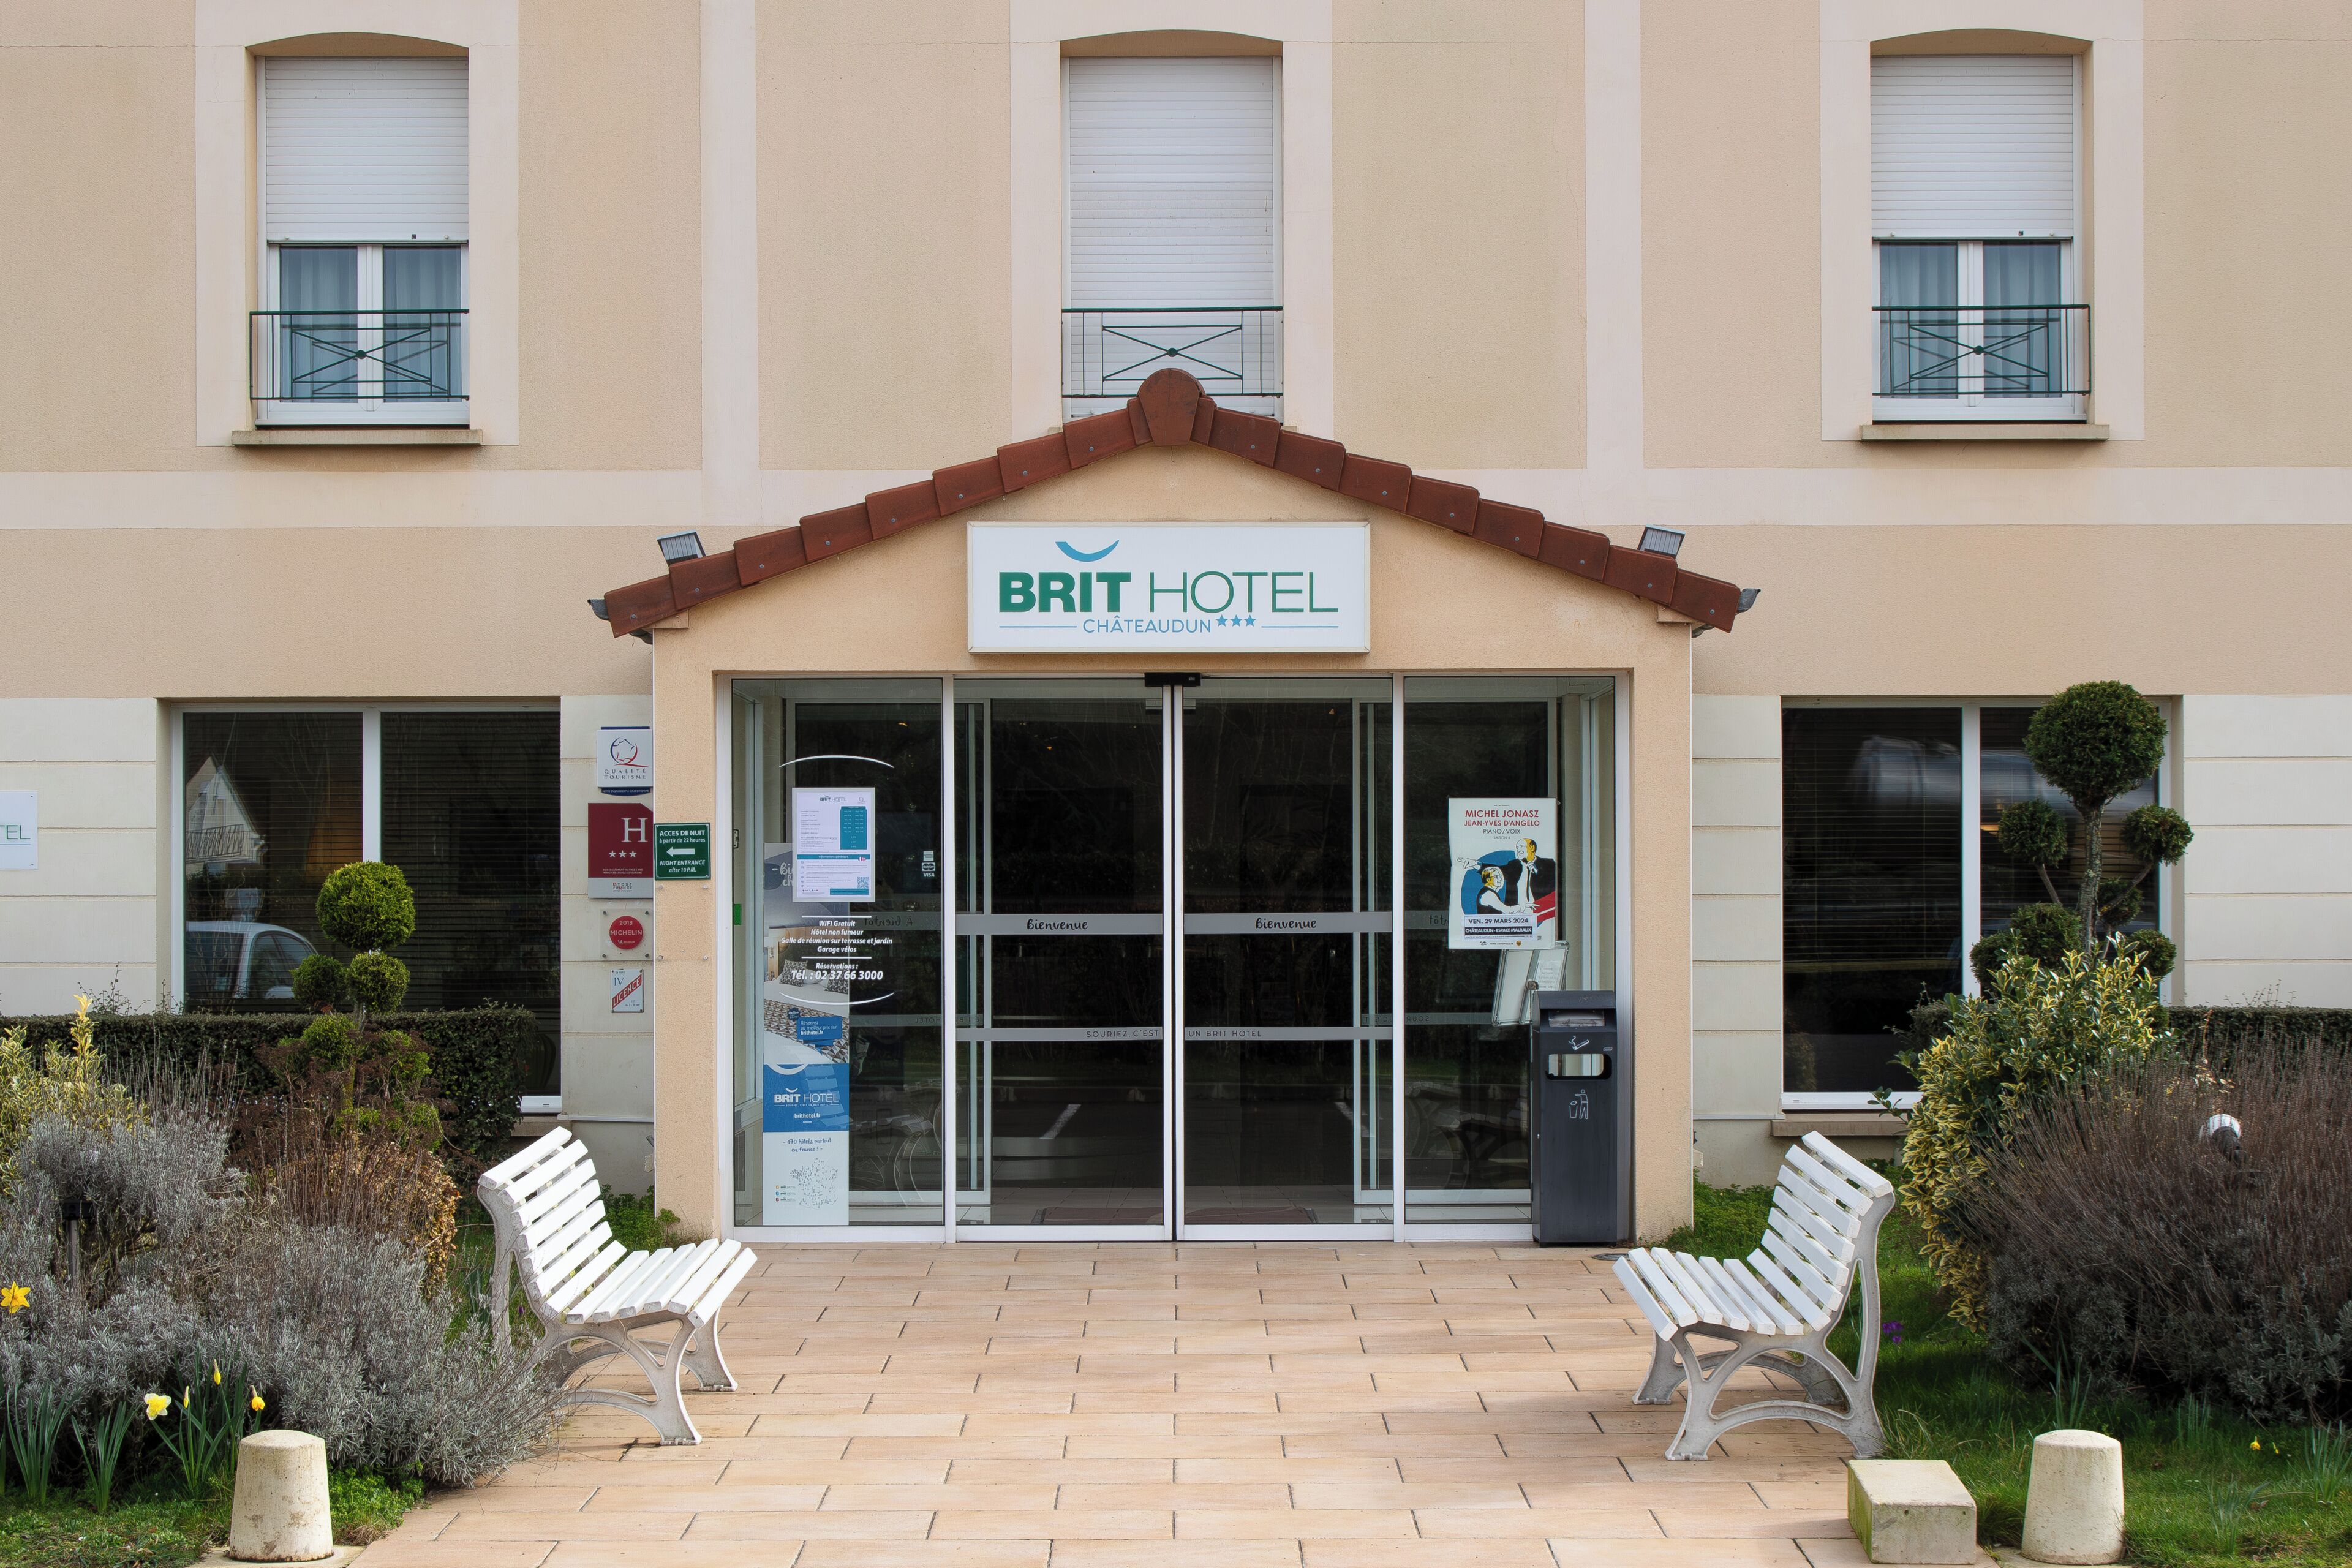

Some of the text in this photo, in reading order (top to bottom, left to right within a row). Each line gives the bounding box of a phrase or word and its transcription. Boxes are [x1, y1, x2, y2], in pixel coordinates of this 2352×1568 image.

[999, 571, 1339, 613] BRIT HOTEL
[1083, 615, 1211, 633] CHÂTEAUDUN
[0, 825, 31, 839] EL
[621, 818, 648, 842] H
[1027, 919, 1088, 930] bienvenue
[1256, 918, 1317, 929] bienvenue
[792, 970, 807, 979] Tél.
[815, 971, 827, 979] 02
[829, 971, 841, 979] 37
[843, 971, 856, 979] 66
[858, 970, 883, 980] 3000
[613, 976, 641, 1006] LICENCE
[774, 1093, 839, 1102] BRIT HOTEL
